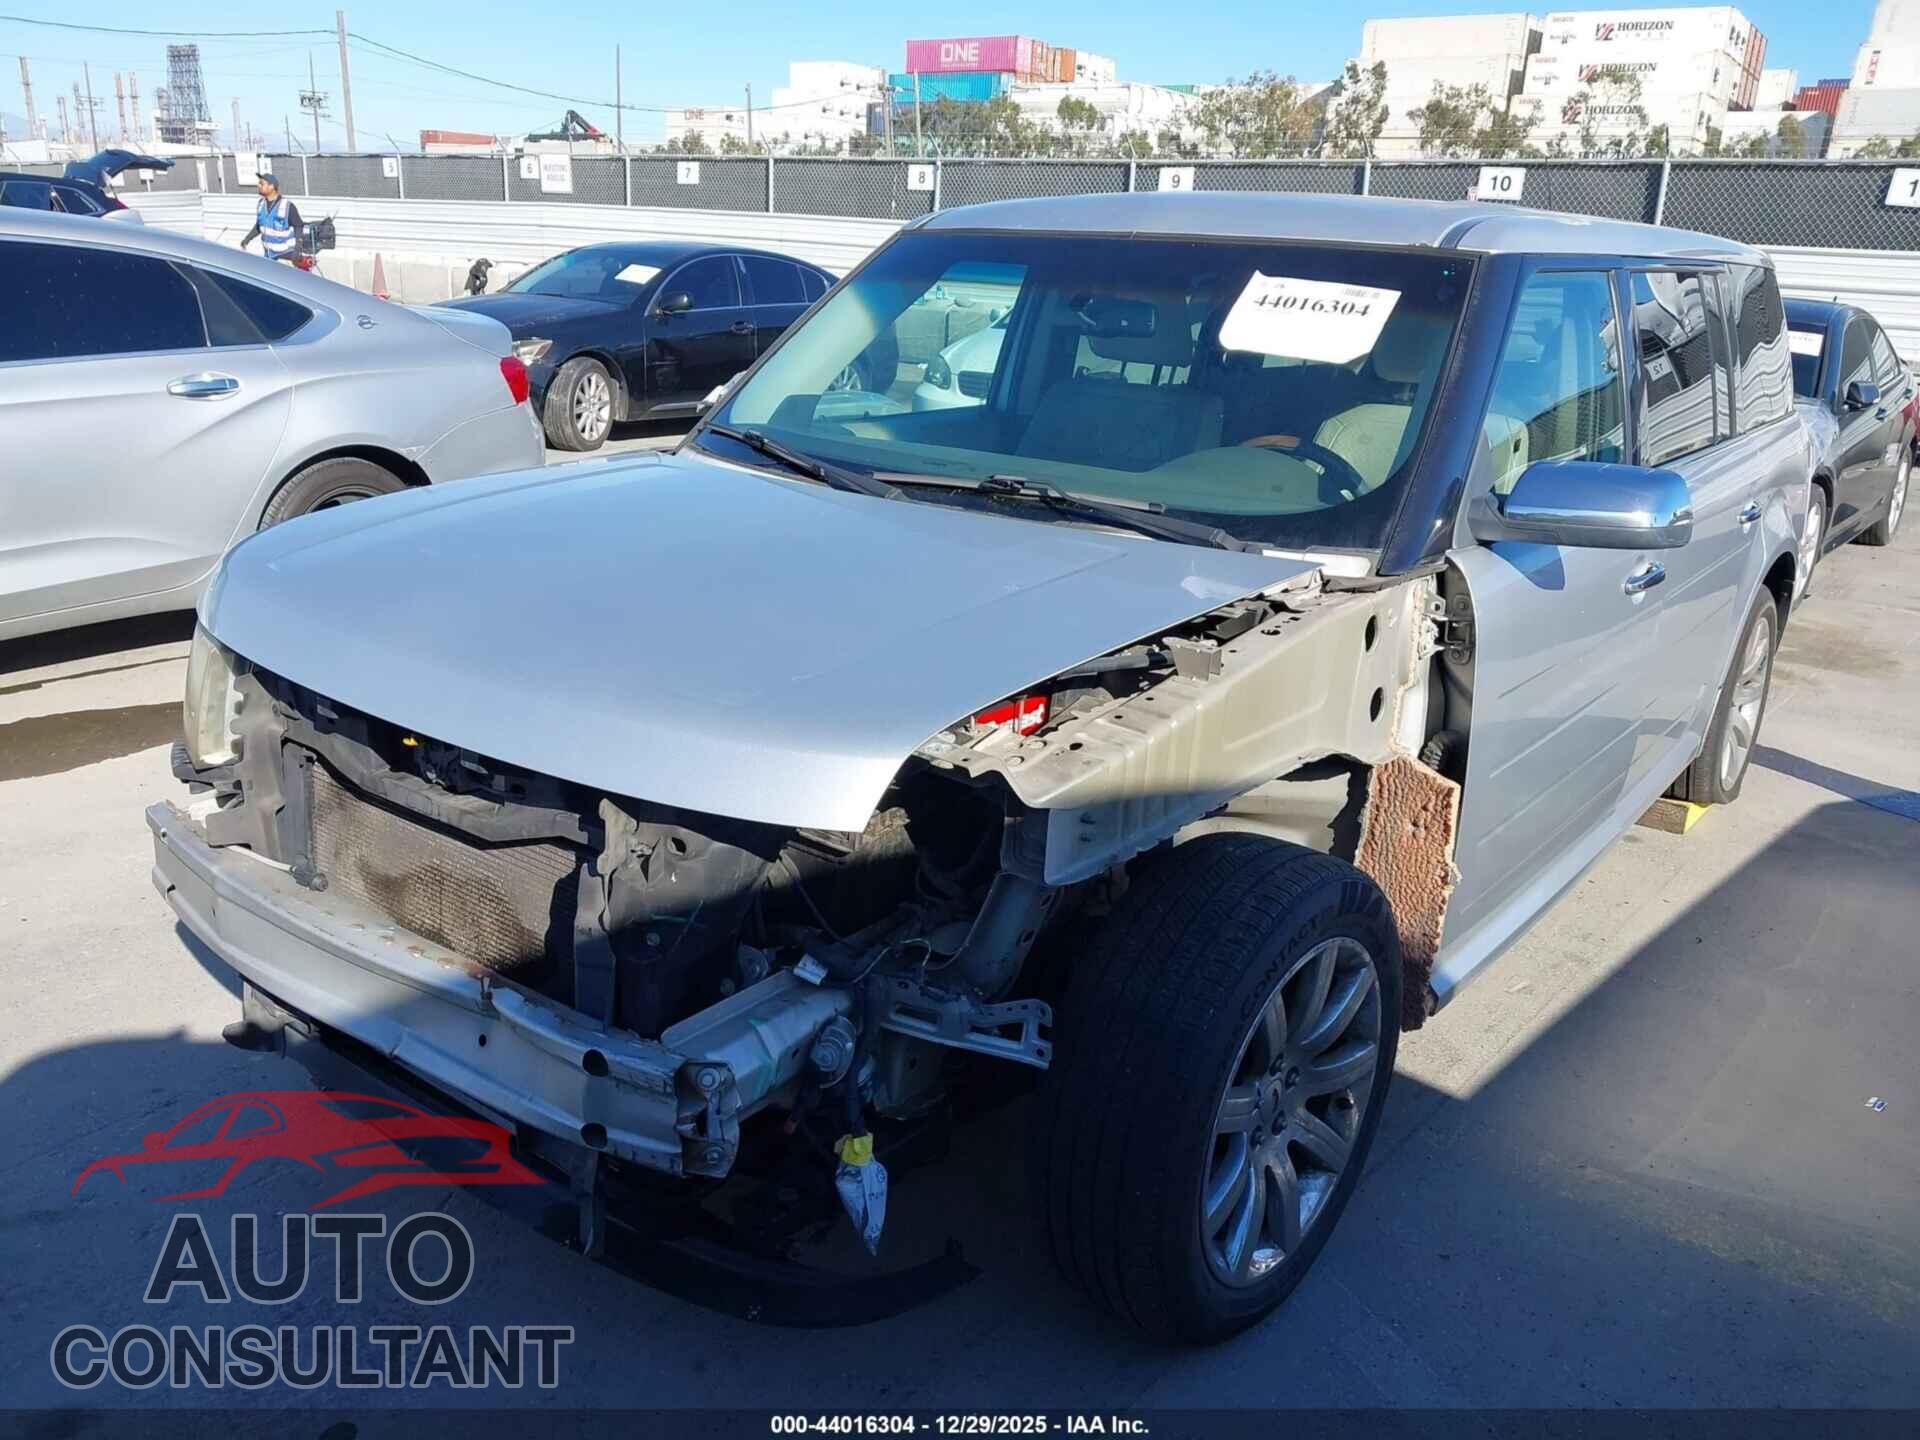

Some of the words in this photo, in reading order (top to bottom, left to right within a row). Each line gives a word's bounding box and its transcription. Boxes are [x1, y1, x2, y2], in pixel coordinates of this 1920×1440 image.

[1617, 21, 1674, 32] HORIZON
[940, 42, 980, 63] ONE
[1600, 62, 1657, 73] HORIZON
[1585, 104, 1642, 115] HORIZON
[684, 167, 692, 179] 7
[917, 170, 926, 184] 8
[1171, 174, 1181, 189] 9
[1490, 175, 1512, 192] 10
[1254, 293, 1371, 317] 44016304
